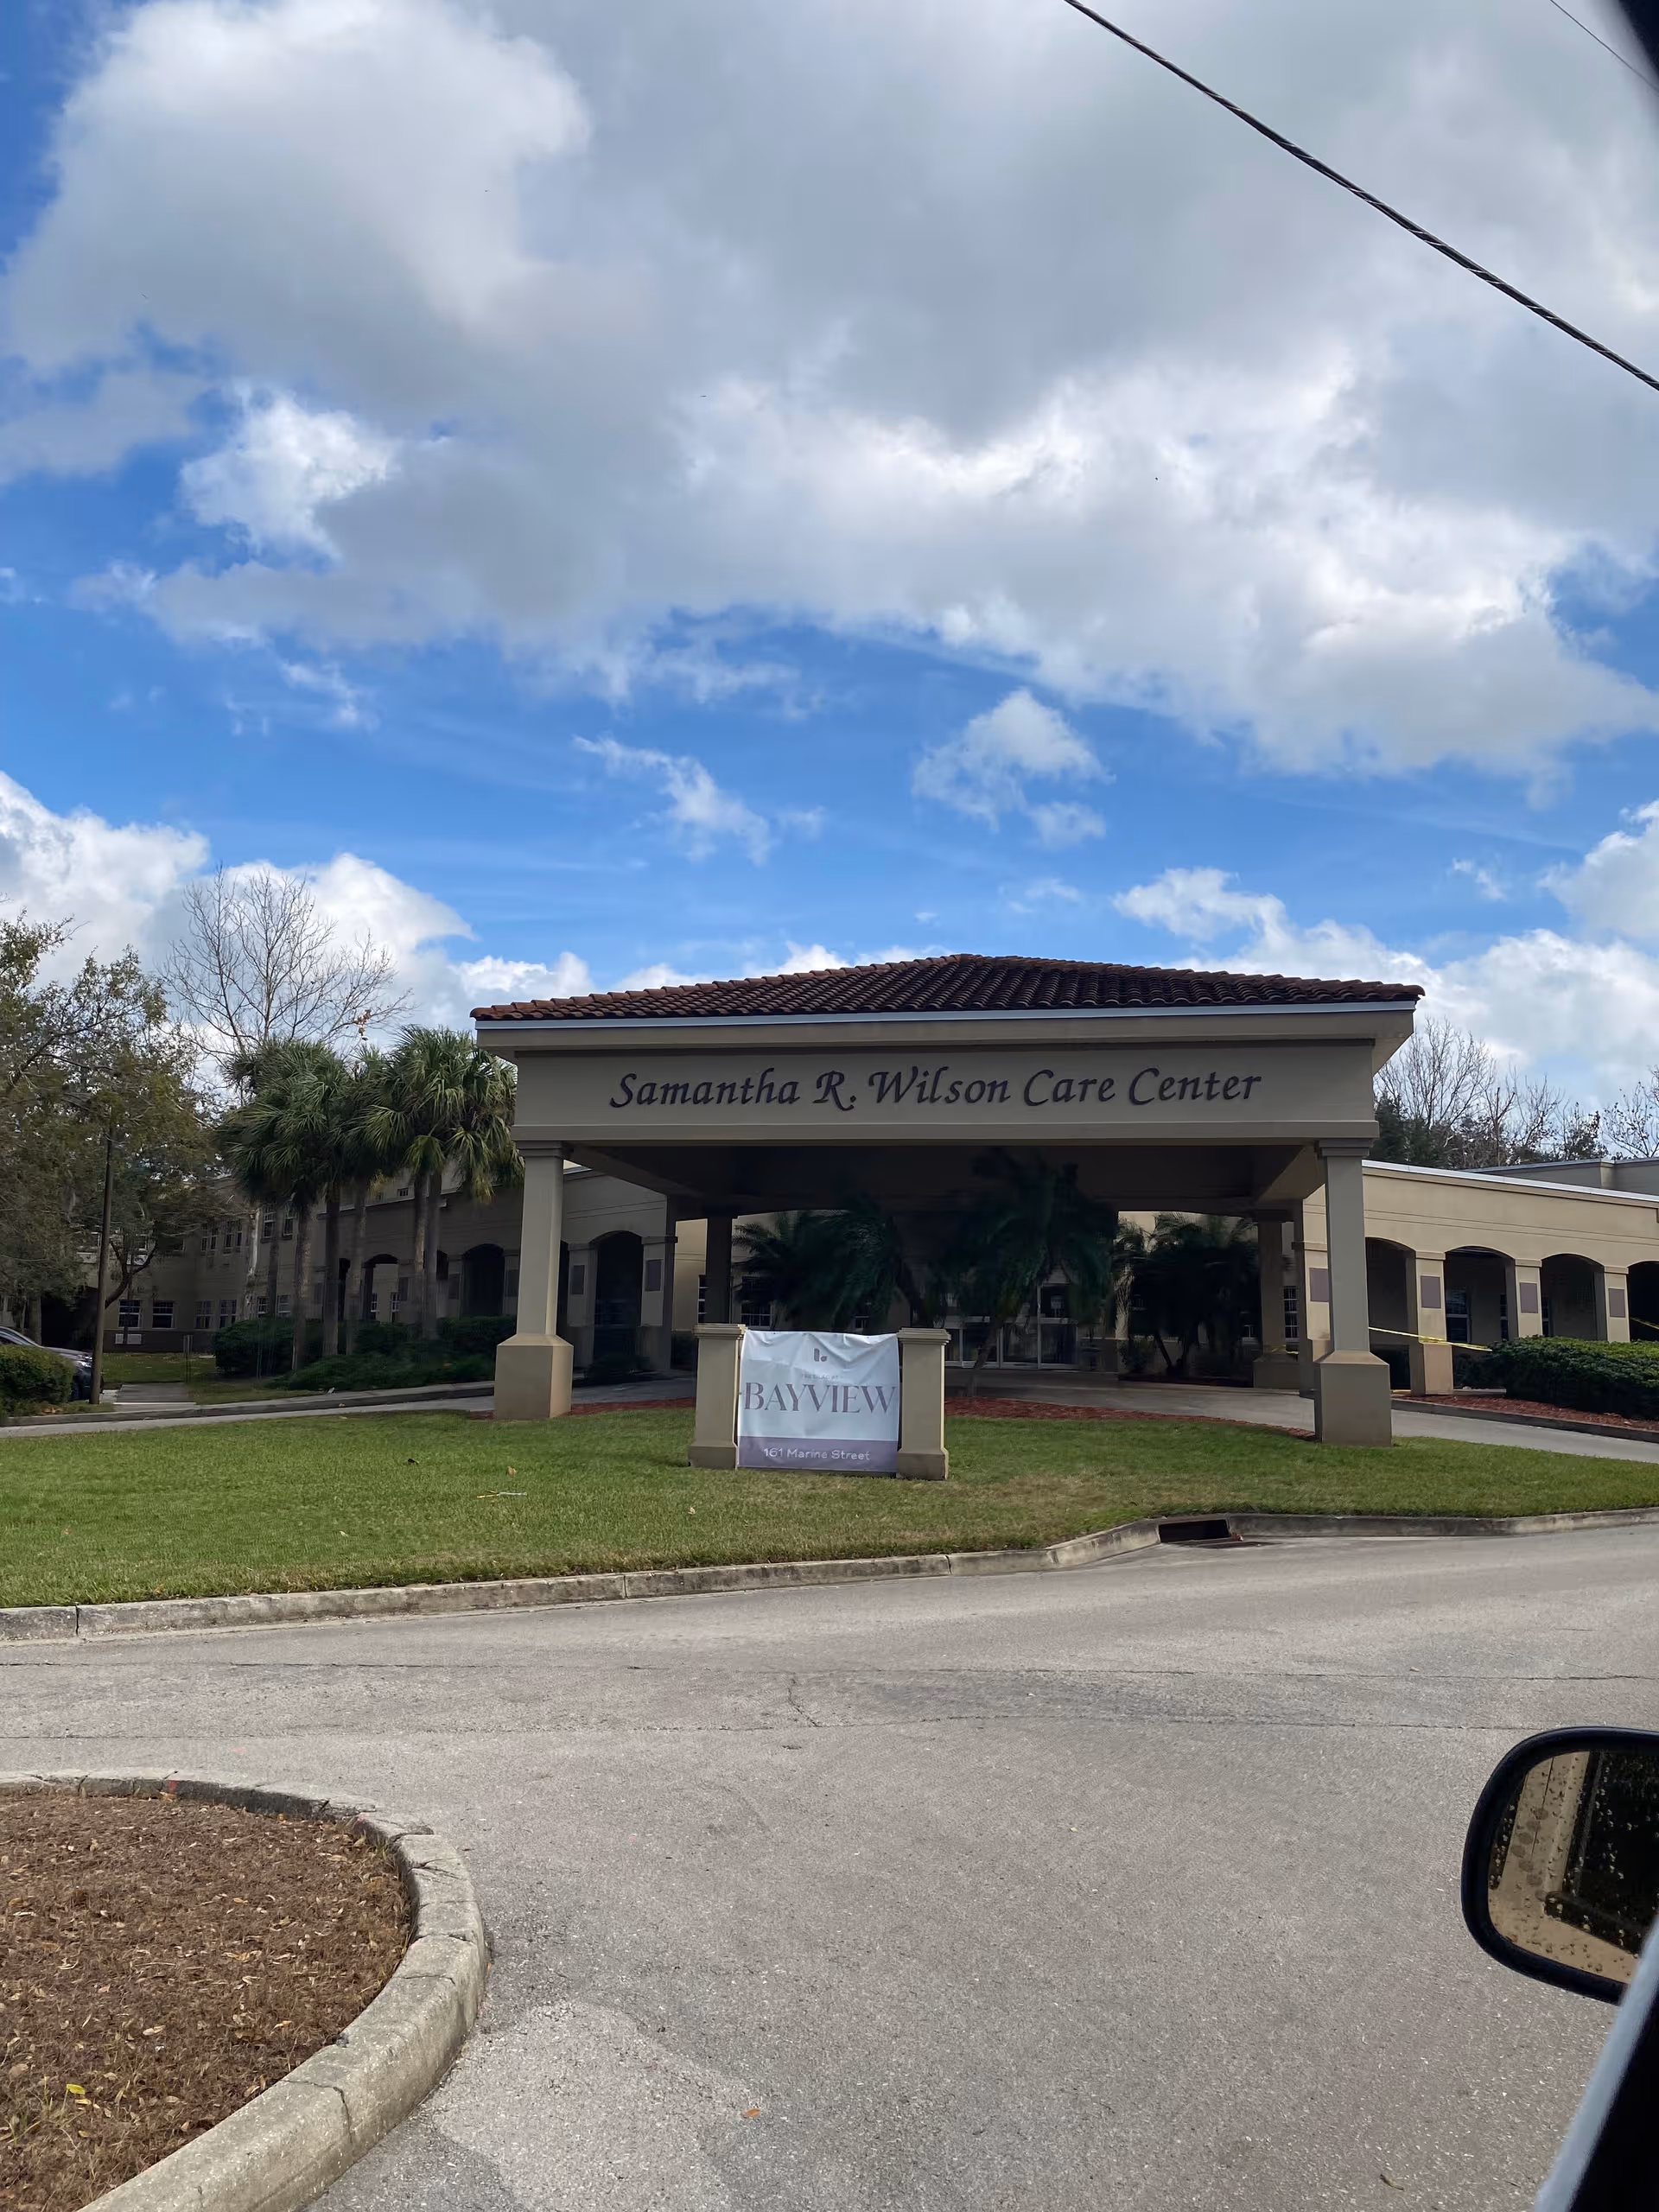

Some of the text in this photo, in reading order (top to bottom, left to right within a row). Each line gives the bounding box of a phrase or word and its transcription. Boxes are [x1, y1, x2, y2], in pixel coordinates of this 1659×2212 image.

[610, 1066, 1262, 1111] Samantha R. Wilson Care Center
[744, 1382, 896, 1413] BAYVIEW
[764, 1447, 870, 1460] 161 Marine Street
